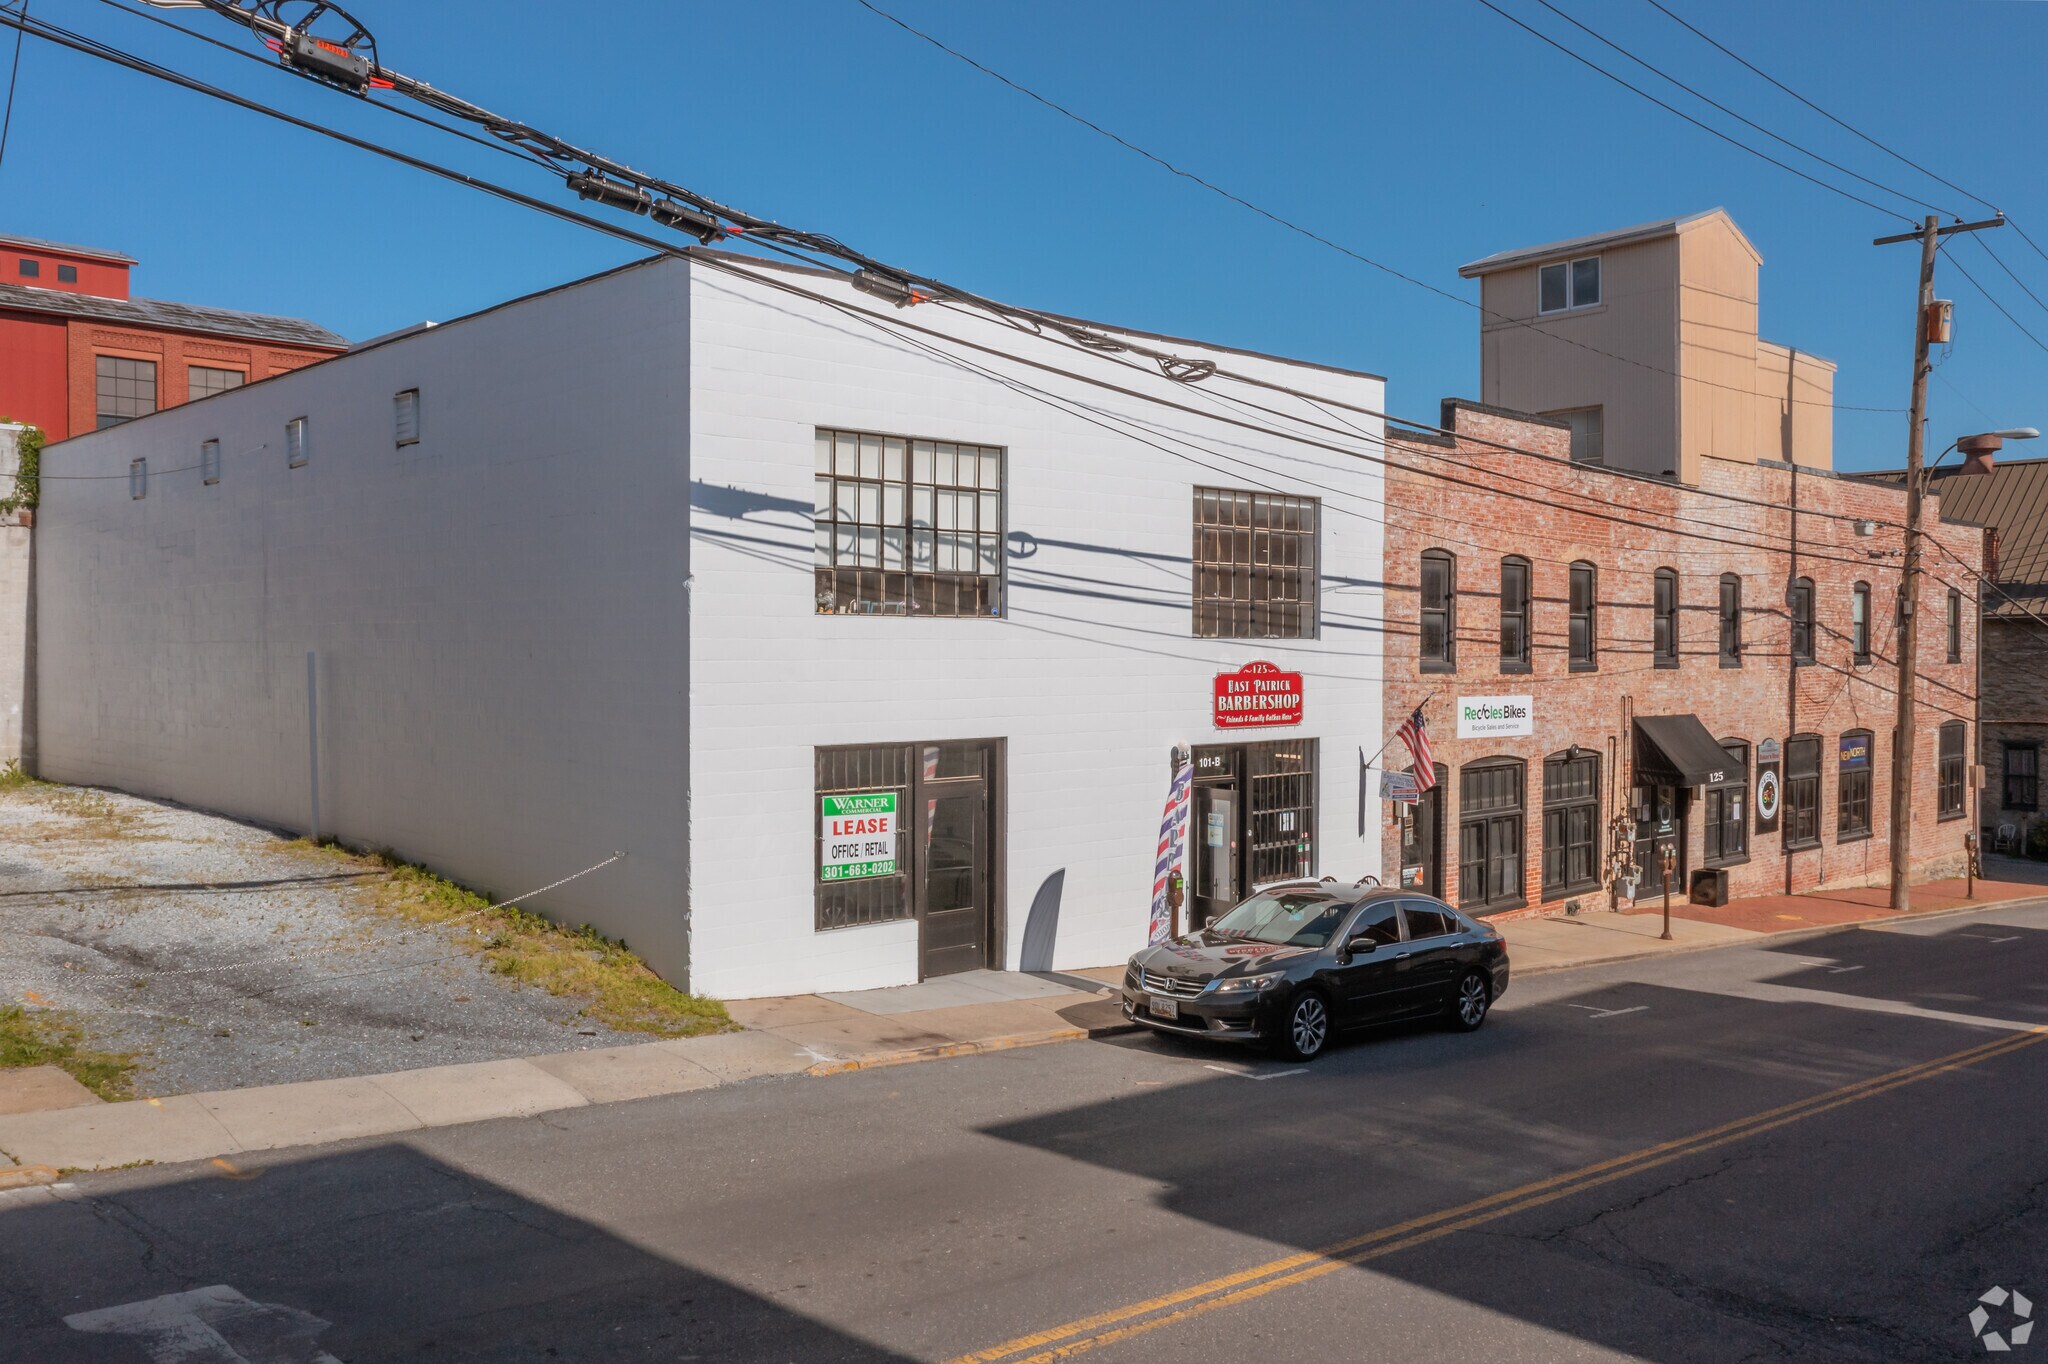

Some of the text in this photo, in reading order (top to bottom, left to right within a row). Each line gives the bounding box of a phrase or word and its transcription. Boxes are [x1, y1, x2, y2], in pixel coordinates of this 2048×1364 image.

[1252, 664, 1268, 674] 125
[1228, 679, 1291, 694] EAST PATRICK
[1218, 693, 1300, 711] BARBERSHOP
[1503, 704, 1527, 719] Bikes
[1472, 724, 1487, 732] Bicycle
[1709, 771, 1724, 782] 125
[831, 797, 889, 810] WARNER
[832, 818, 888, 836] LEASE
[831, 843, 859, 860] OFFICE
[865, 841, 888, 857] RETAIL
[824, 861, 894, 878] 301-663-0202
